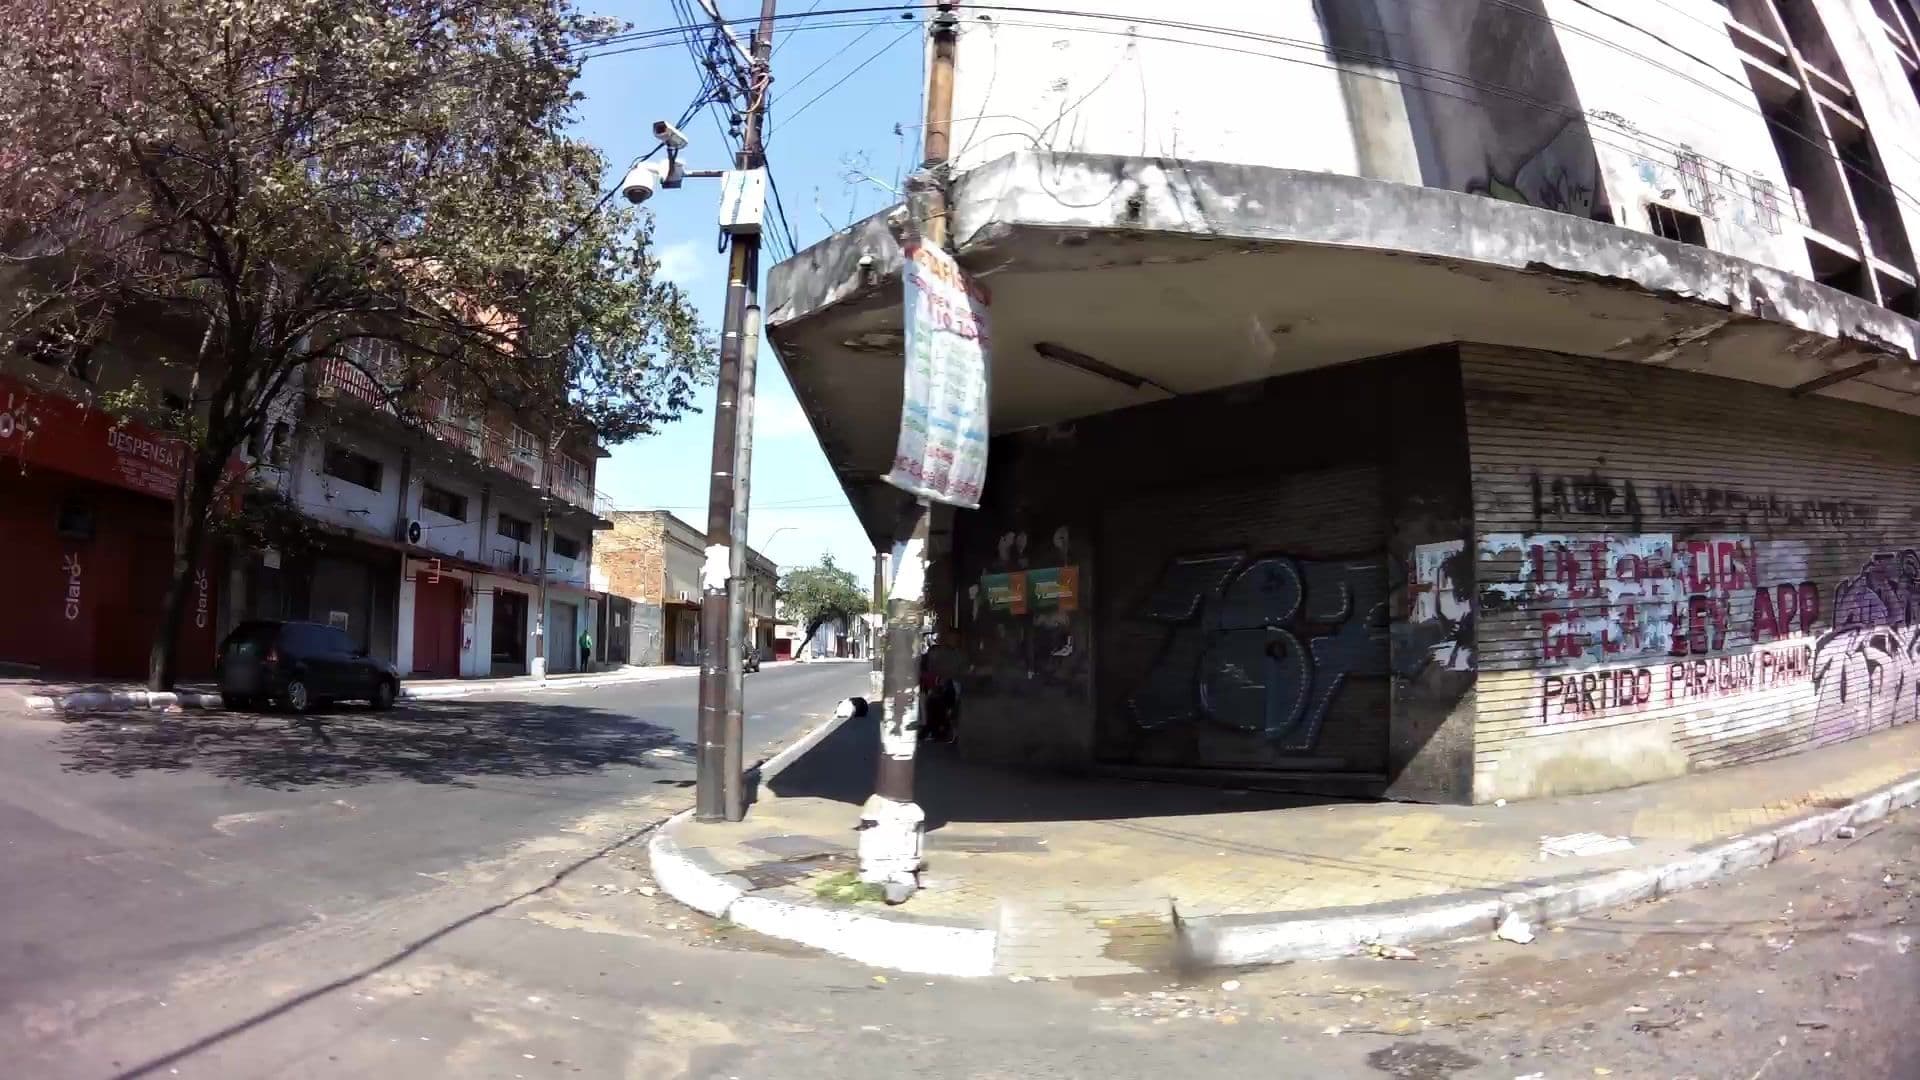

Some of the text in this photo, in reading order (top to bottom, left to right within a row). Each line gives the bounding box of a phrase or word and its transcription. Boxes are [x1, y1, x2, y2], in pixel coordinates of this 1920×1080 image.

[107, 427, 174, 468] DESPENSA
[64, 558, 82, 621] Claro
[195, 572, 209, 629] Claro
[1752, 581, 1820, 641] APP
[1542, 667, 1653, 724] PARTIDO
[1666, 651, 1758, 705] PARAGUAY
